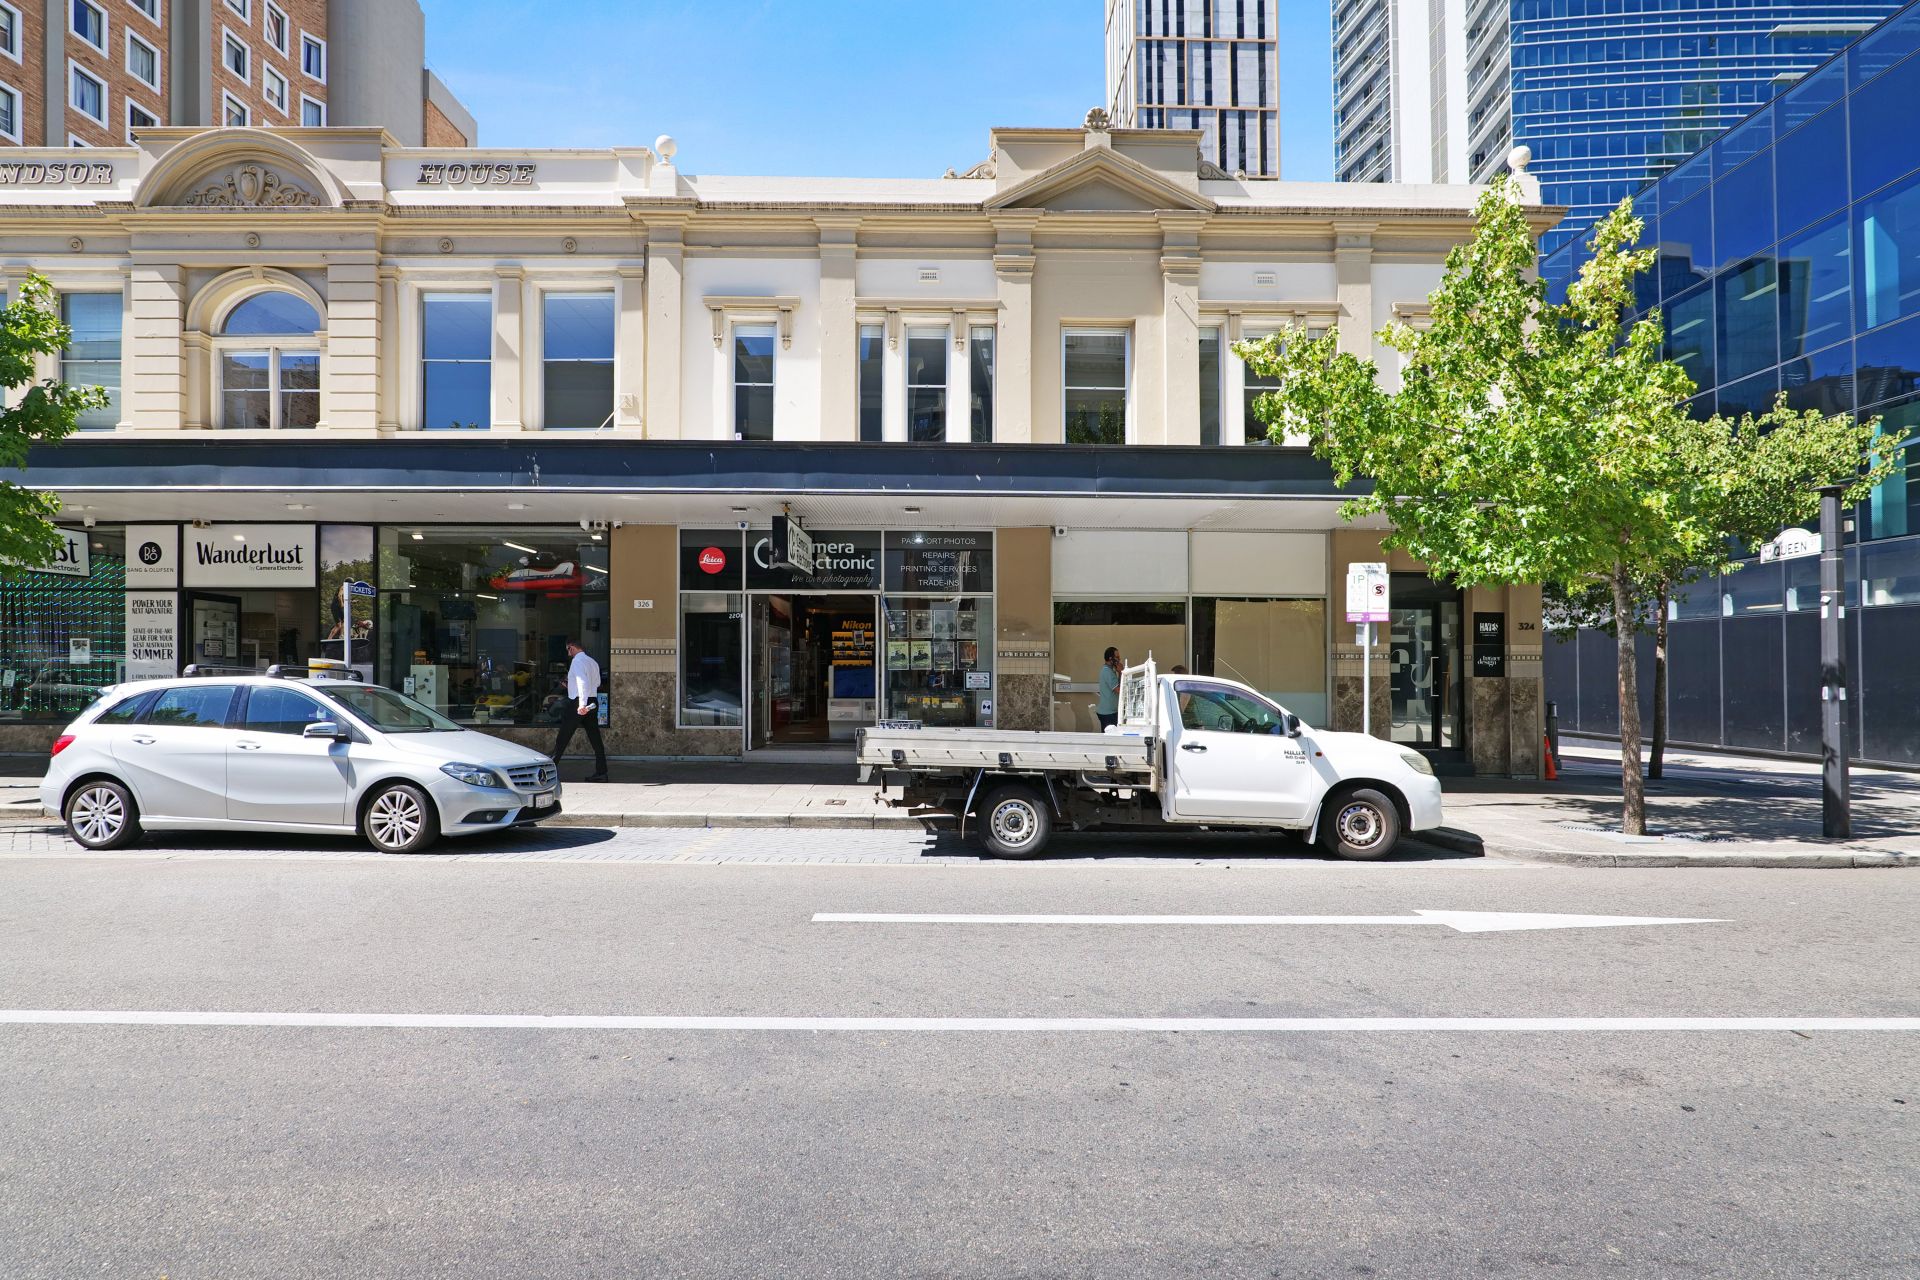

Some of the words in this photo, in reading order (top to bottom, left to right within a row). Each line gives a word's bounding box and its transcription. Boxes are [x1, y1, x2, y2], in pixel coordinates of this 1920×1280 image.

[416, 163, 536, 184] HOUSE
[901, 537, 943, 545] PASPORT
[944, 537, 976, 545] PHOTOS
[196, 541, 304, 565] Wanderlust
[812, 542, 855, 554] mera
[1773, 541, 1807, 557] QUEEN
[700, 553, 723, 564] Leica
[900, 565, 937, 573] PRINTING
[938, 565, 978, 573] SERVICES
[821, 573, 874, 587] photography
[918, 579, 960, 587] TRADE-INS
[841, 620, 872, 630] Nikon
[1518, 622, 1535, 631] 324
[132, 649, 174, 660] SUMMER
